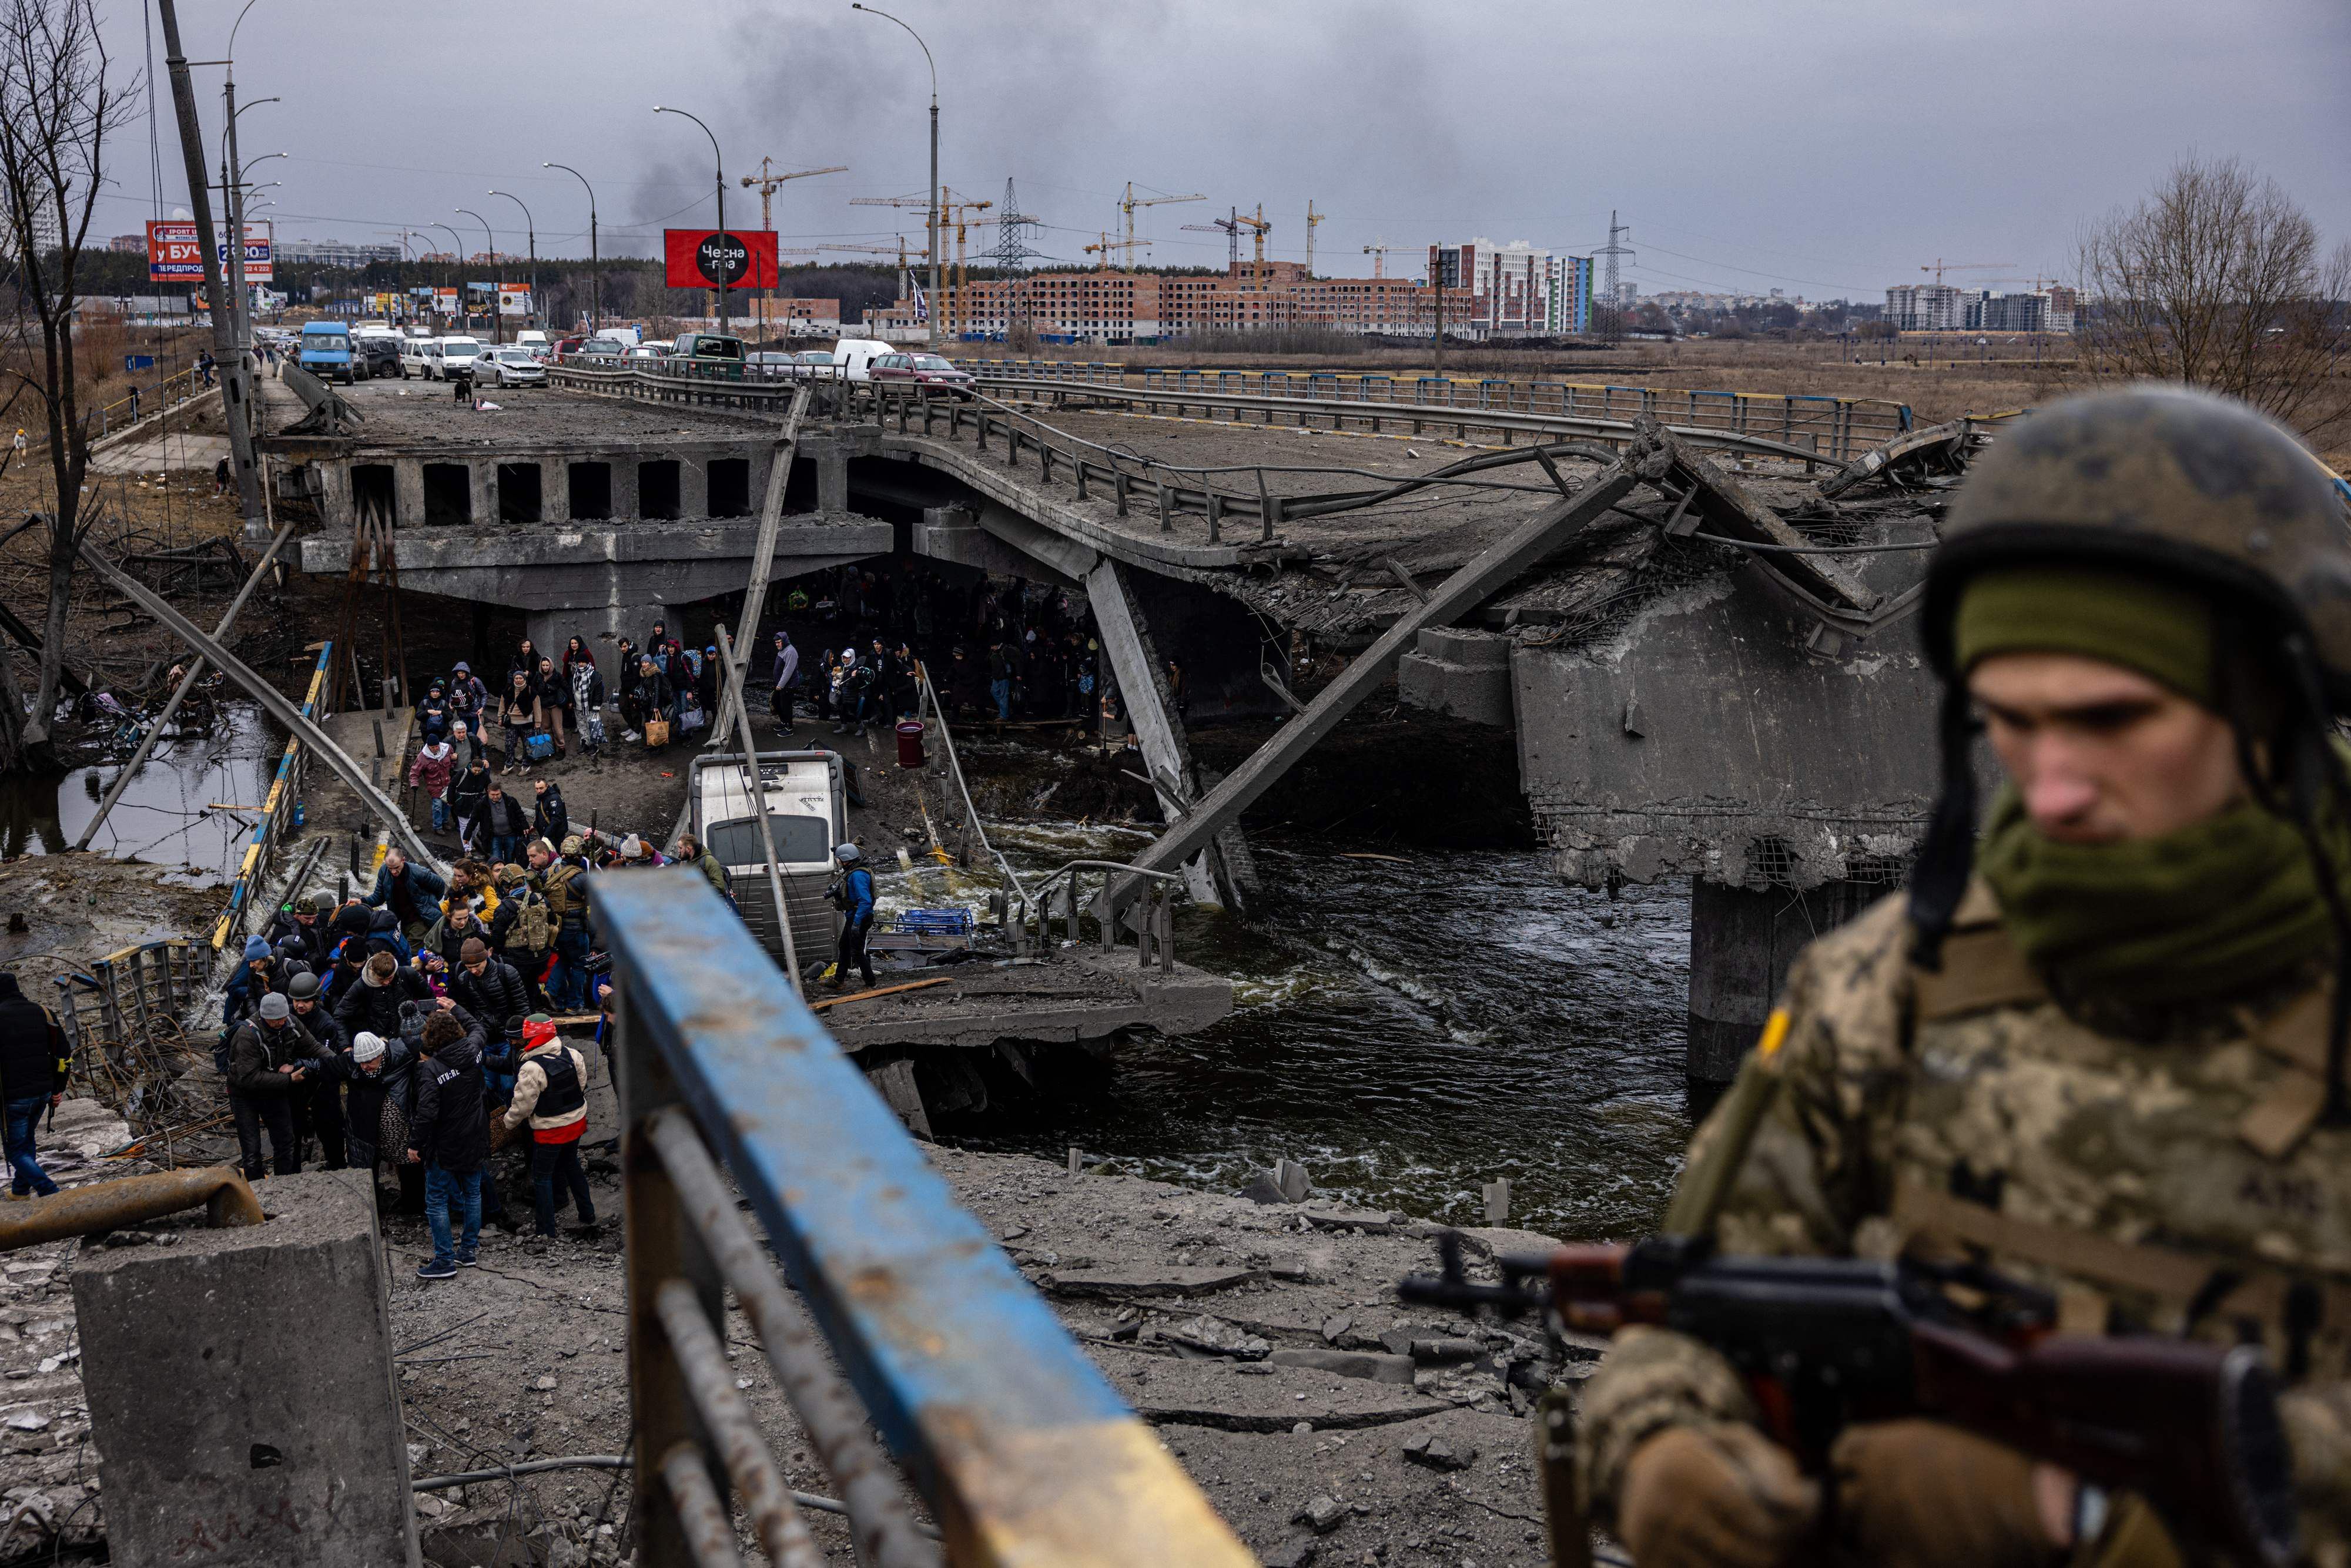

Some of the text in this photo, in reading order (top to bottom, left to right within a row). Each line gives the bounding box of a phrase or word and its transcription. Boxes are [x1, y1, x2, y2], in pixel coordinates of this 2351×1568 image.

[158, 245, 201, 262] у БУЧ
[221, 246, 259, 259] 20
[702, 244, 745, 259] Чесна
[158, 264, 204, 273] ПЕРЕДПРОД
[712, 260, 735, 269] га
